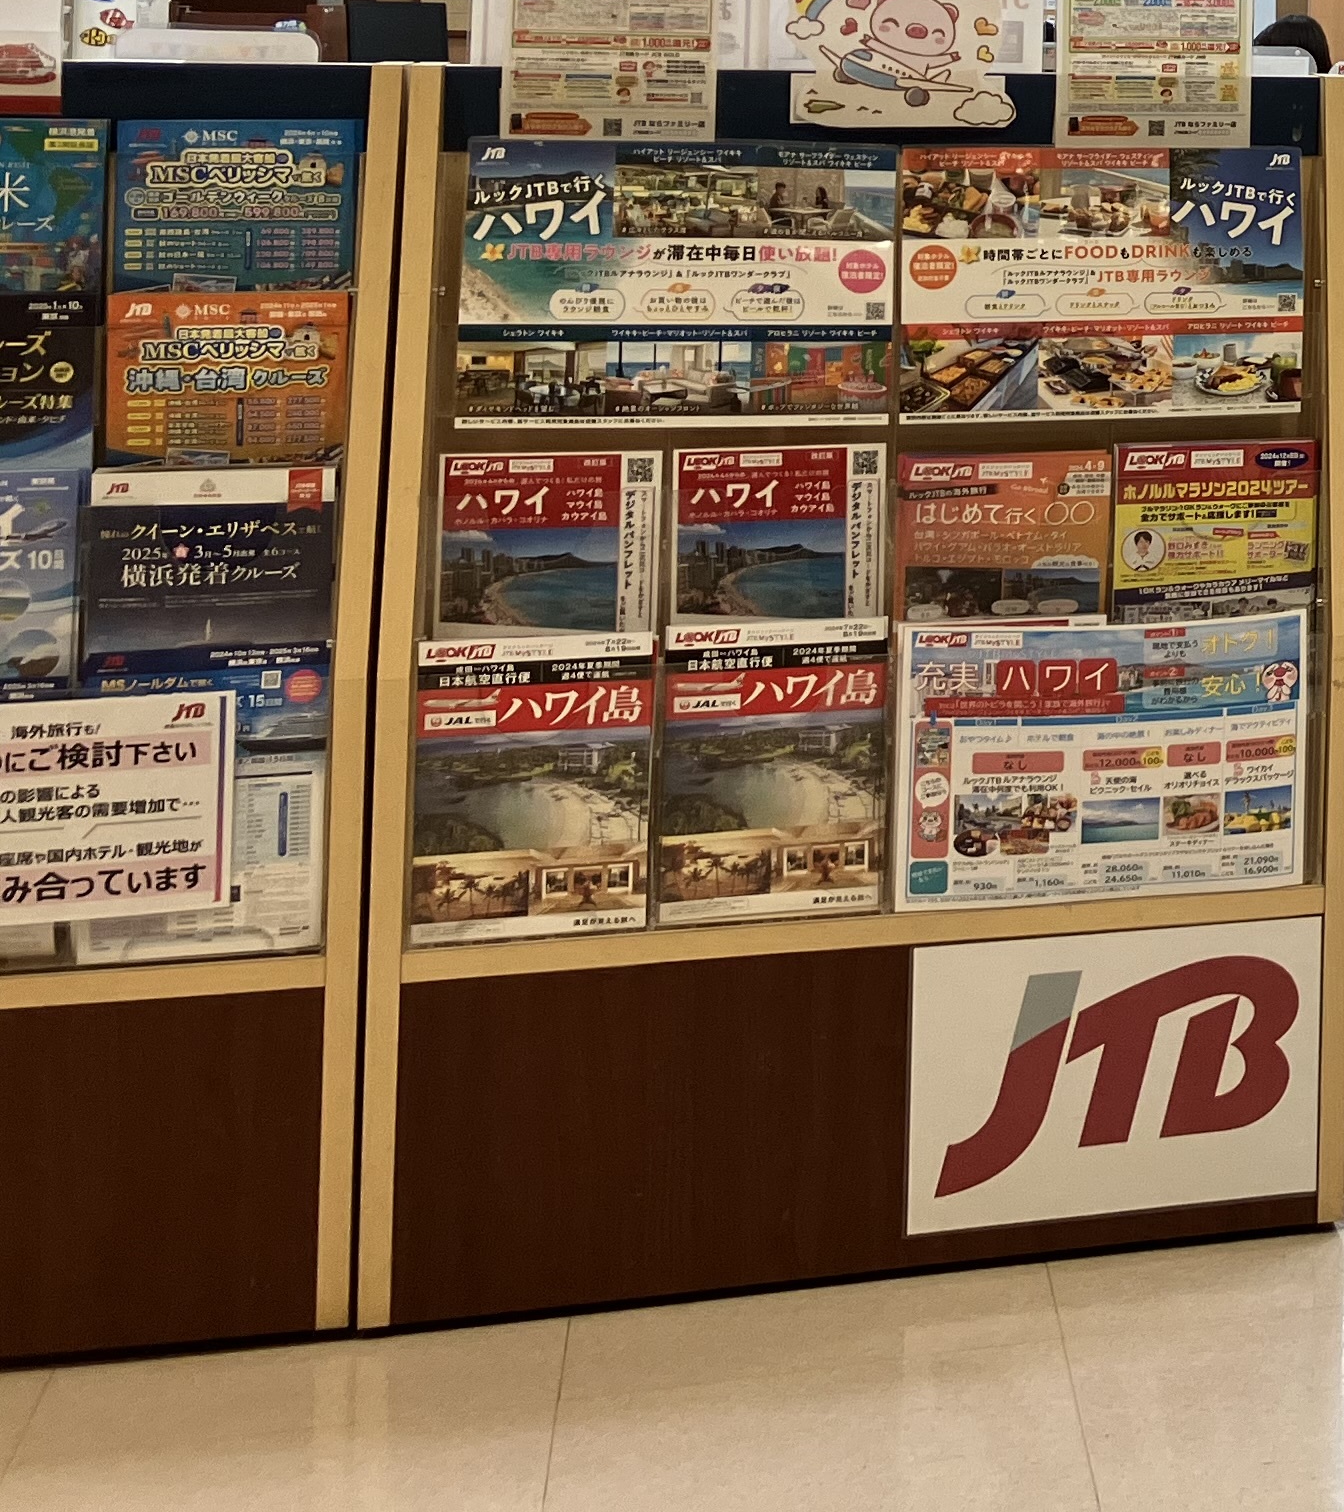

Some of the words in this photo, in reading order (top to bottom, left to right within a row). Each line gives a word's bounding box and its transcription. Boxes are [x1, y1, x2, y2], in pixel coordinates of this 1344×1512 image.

[202, 130, 238, 141] MSC
[481, 146, 506, 161] JTB
[1269, 153, 1291, 167] JTB
[473, 174, 605, 206] ルックJTBで行く
[1180, 177, 1296, 207] ルックJTBで行く
[471, 190, 608, 241] ハワイ
[1170, 198, 1295, 246] ハワイ
[506, 243, 838, 263] JTB専用ラウンジが滞在中毎日使い放題!
[1097, 269, 1211, 284] JTB専用ラウンジ
[125, 303, 152, 317] JTB
[194, 304, 230, 316] MSC
[107, 482, 130, 495] JTB
[566, 488, 603, 498] ハワイ島
[690, 479, 780, 509] ハワイ
[795, 481, 831, 490] ハワイ島
[1123, 479, 1309, 500] ホノルルマラソン2024ツアー
[456, 486, 549, 515] ハワイ
[566, 500, 603, 509] マウイ島
[795, 491, 831, 501] マウイ島
[561, 511, 607, 521] カウアイ島
[790, 502, 835, 514] カウアイ島
[850, 481, 862, 579] デジタルパンフレット
[624, 490, 635, 589] デジタルパンフレット
[121, 562, 300, 588] 横浜発着クルーズ
[675, 631, 714, 646] LOOK
[1201, 628, 1275, 656] オトク!
[426, 646, 467, 662] LOOK
[688, 655, 774, 671] 日本航空直行便
[439, 671, 531, 687] 日本航空直行便
[916, 660, 979, 691] 充実
[1002, 663, 1109, 692] ハワイ
[742, 668, 878, 708] ハワイ島
[1201, 672, 1262, 699] 安心!
[172, 703, 206, 722] JTB
[498, 685, 643, 725] ハワイ島
[691, 698, 719, 710] JAL
[445, 716, 473, 725] JAL
[11, 721, 101, 739] 海外旅行も!
[0, 740, 197, 772] にご検討下さい
[1004, 760, 1027, 770] なし
[1164, 779, 1220, 789] オリオリチョイス
[1, 784, 100, 804] の影響による
[2, 864, 206, 903] み合っています
[935, 956, 1299, 1198] JTB
